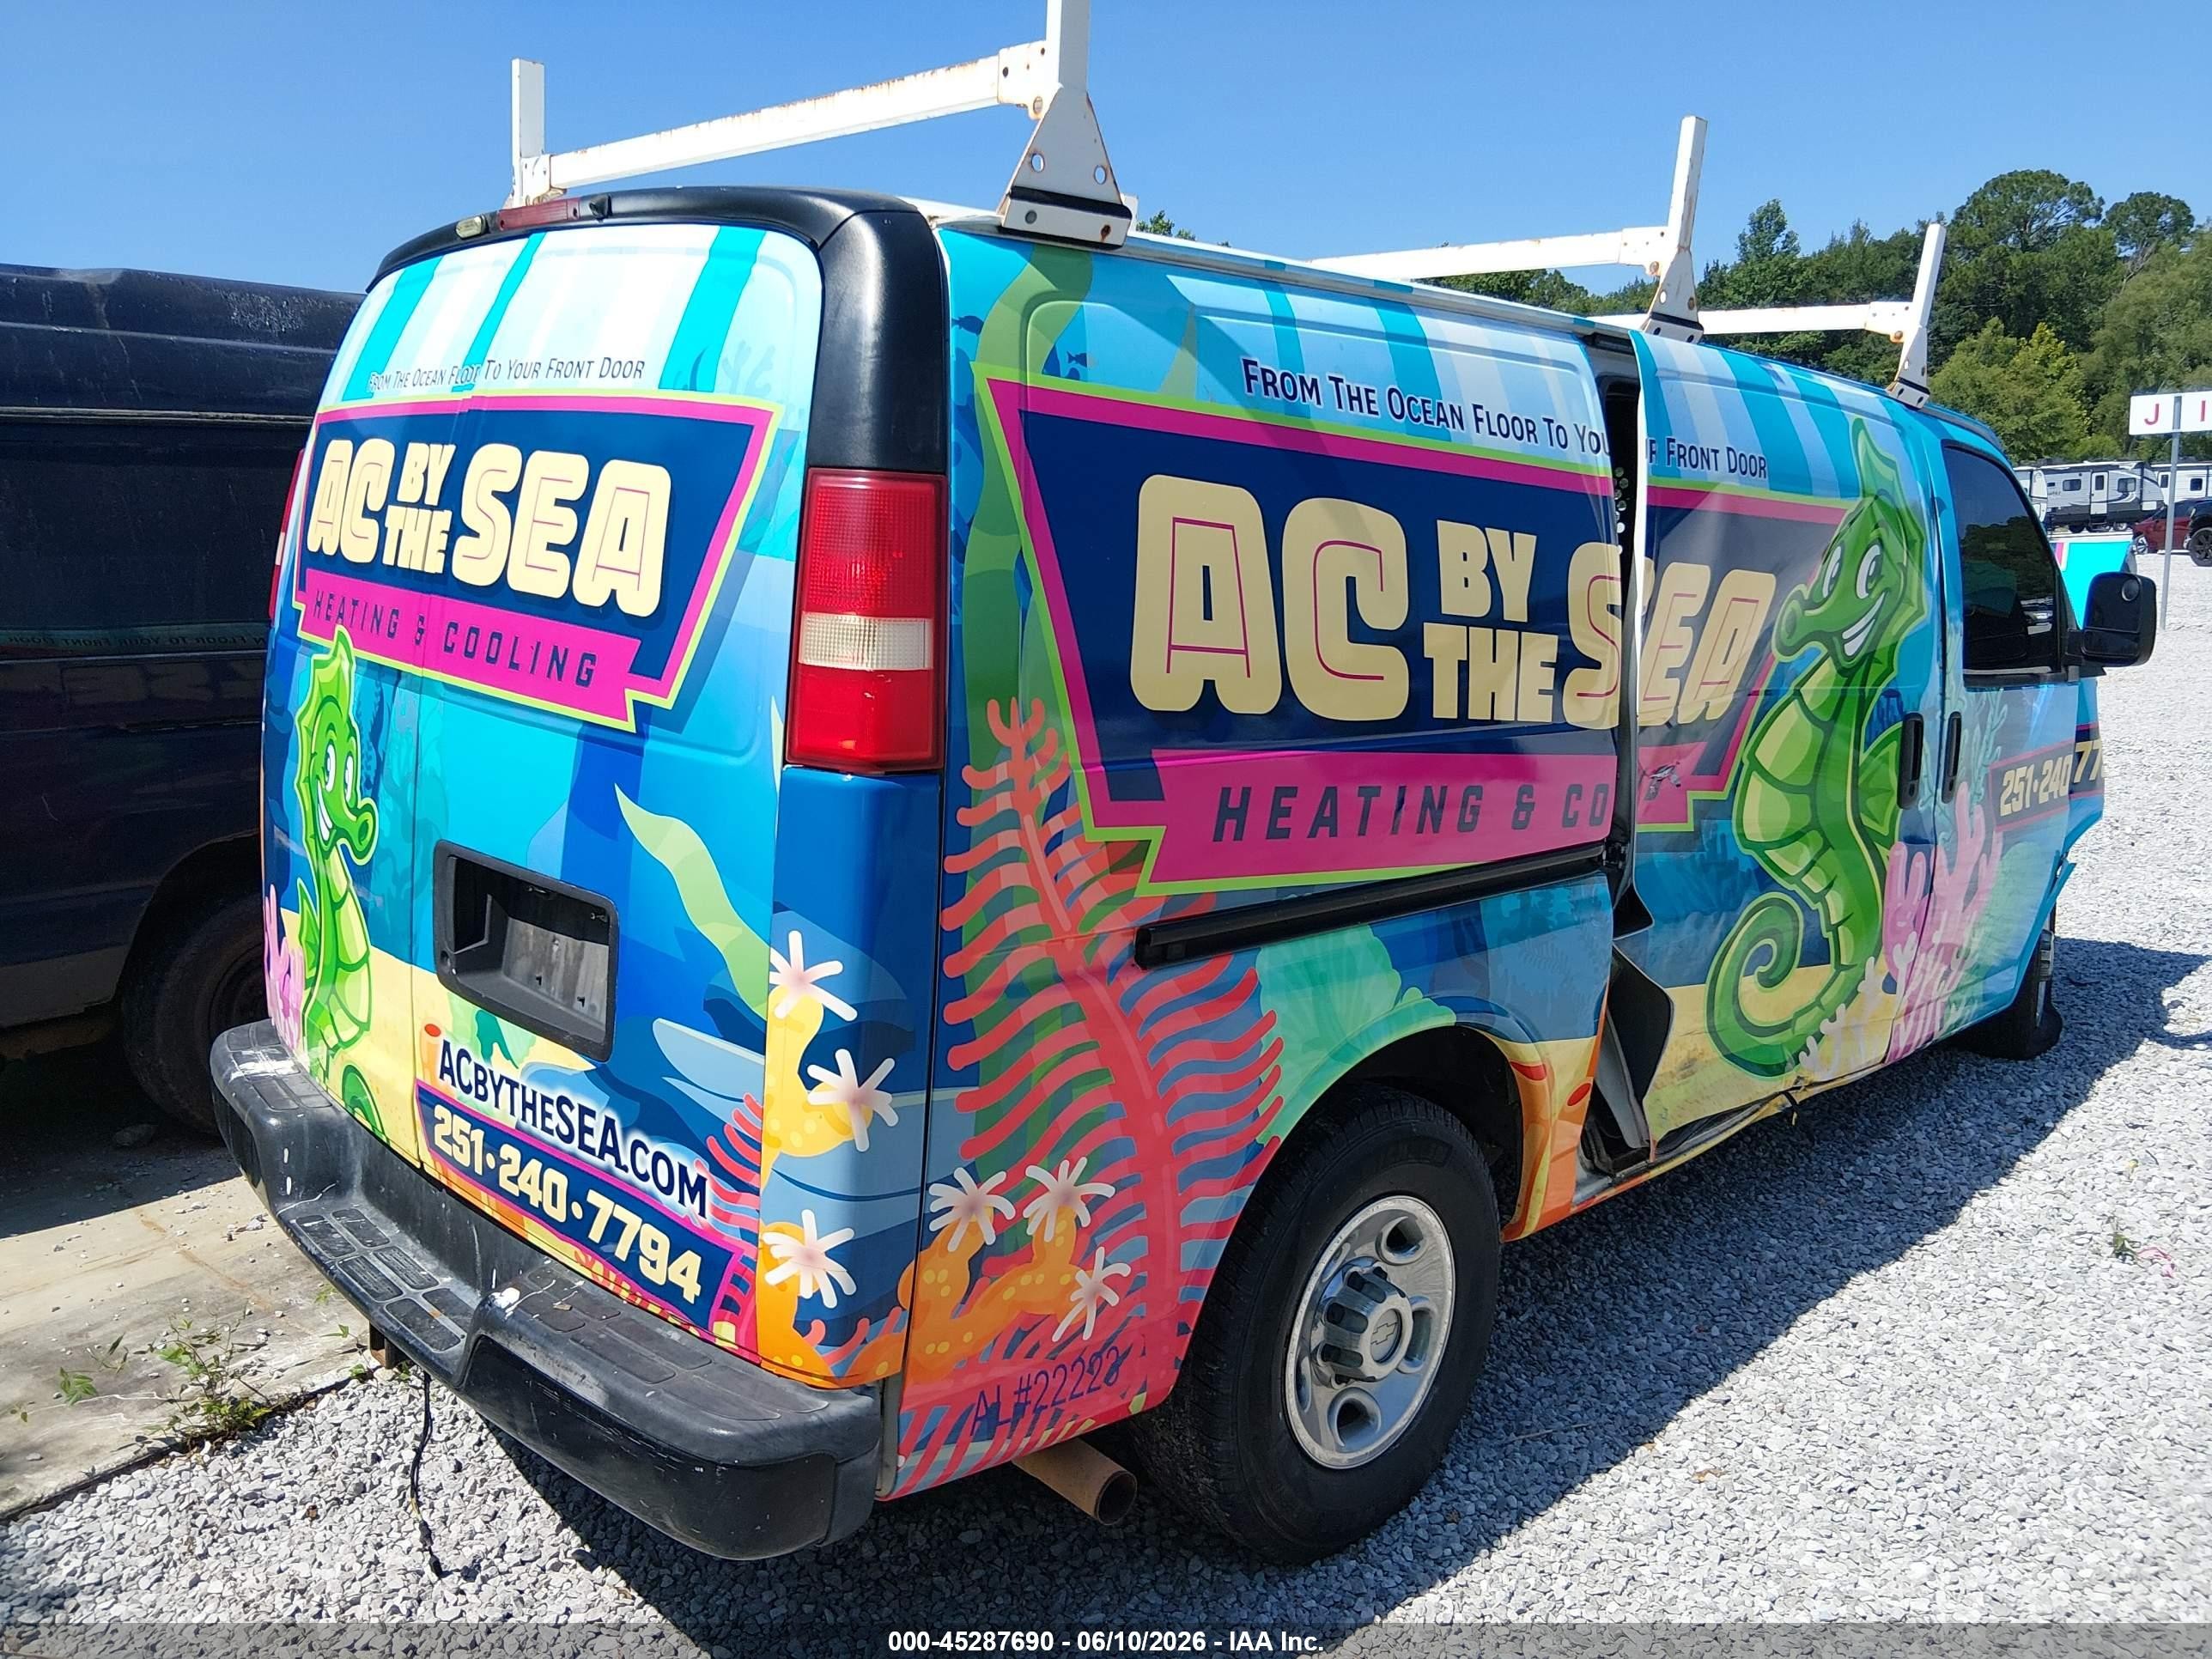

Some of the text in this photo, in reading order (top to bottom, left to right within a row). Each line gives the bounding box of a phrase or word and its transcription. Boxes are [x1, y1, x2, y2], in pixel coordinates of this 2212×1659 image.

[369, 374, 392, 392] FROM
[393, 370, 410, 388] THE
[412, 368, 447, 387] OCEAN
[484, 359, 501, 380] TO
[507, 359, 542, 380] YOUR
[545, 357, 594, 380] FRONT
[599, 356, 645, 380] DOOR
[1242, 358, 1322, 406] FROM
[1328, 375, 1380, 416] THE
[1387, 386, 1465, 431] OCEAN
[1472, 404, 1539, 444] FLOOR
[1542, 416, 1569, 450] TO
[1667, 437, 1720, 472] FRONT
[1726, 447, 1767, 479] DOOR
[307, 438, 672, 617] AC BY THE SEA
[313, 590, 399, 639] HEATING
[443, 621, 598, 688] COOLING
[1130, 474, 1777, 730] AC BY THE SEA
[1212, 782, 1482, 843] HEATING
[1511, 783, 1535, 830] &
[439, 1039, 708, 1218] ACBYTHESEA.COM
[969, 1384, 1012, 1437] AL
